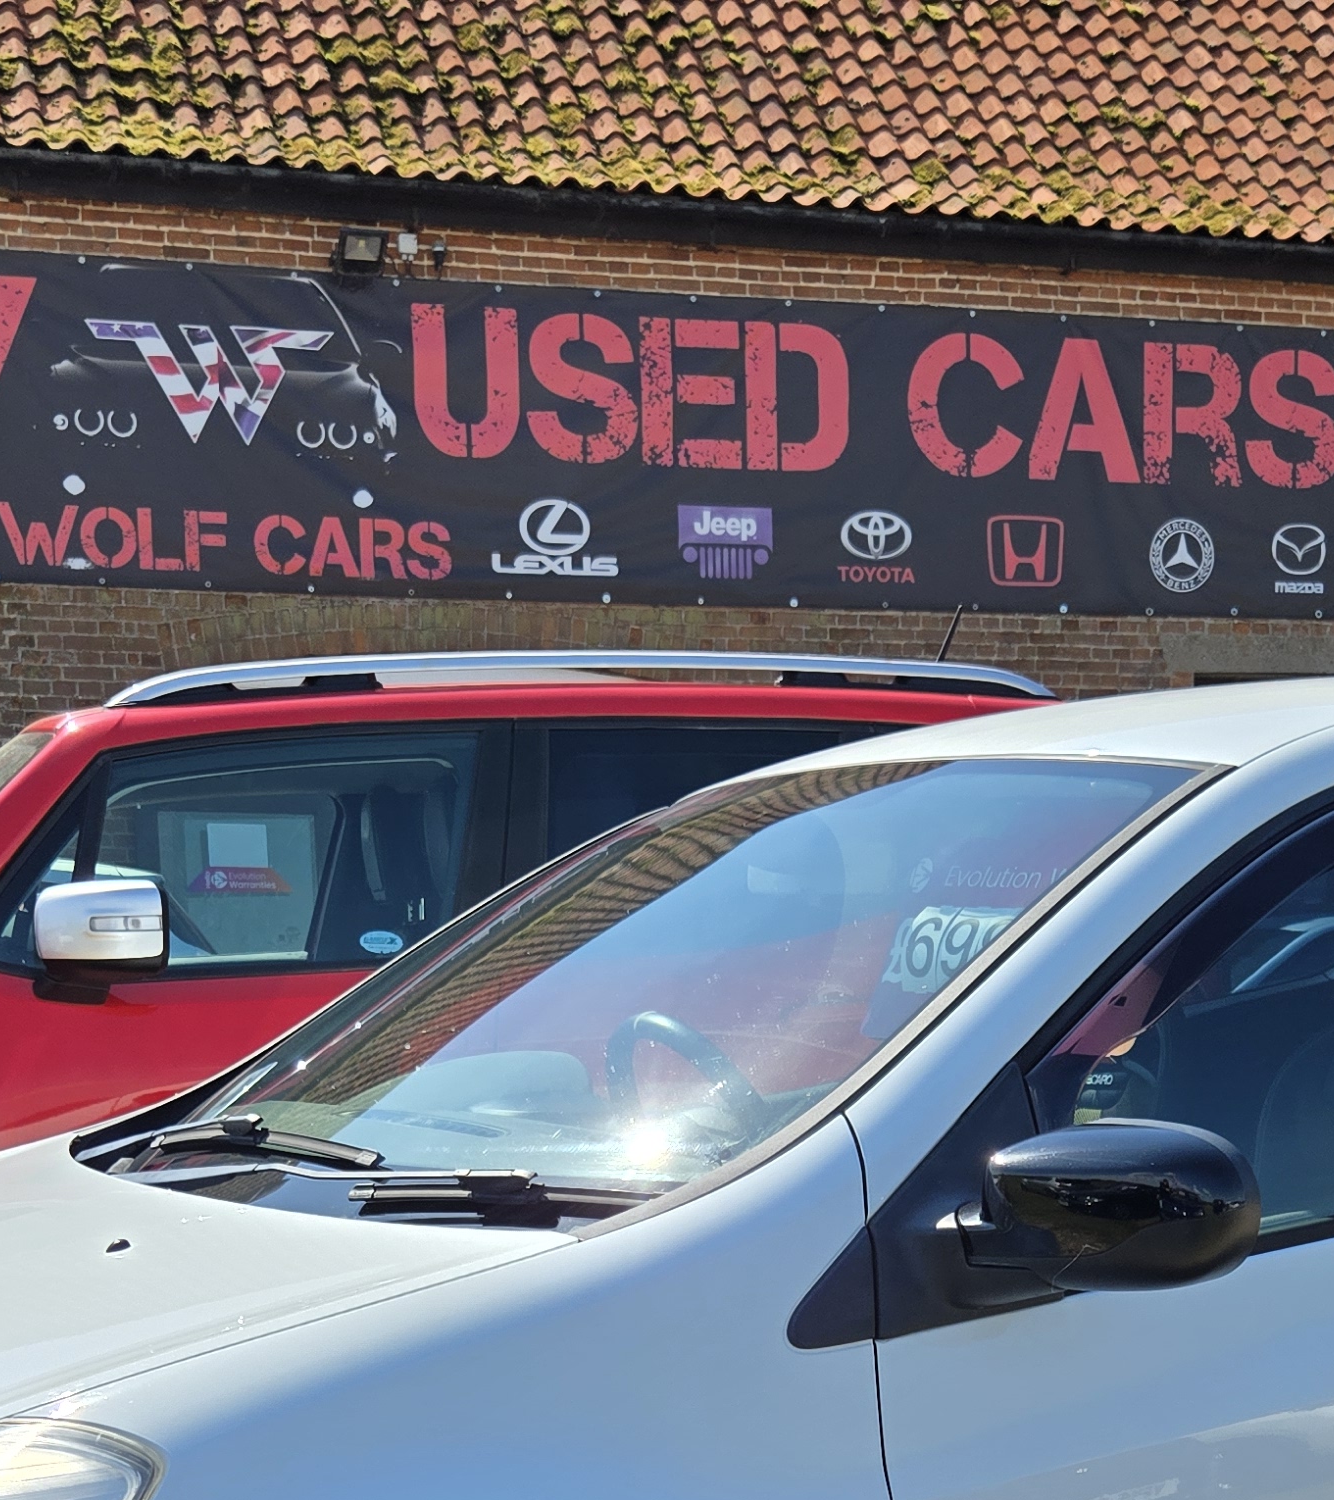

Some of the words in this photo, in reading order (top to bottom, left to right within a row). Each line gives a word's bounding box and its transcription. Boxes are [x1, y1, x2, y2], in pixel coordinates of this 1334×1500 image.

[410, 302, 850, 473] USED
[693, 508, 758, 542] Jeep
[1158, 521, 1207, 543] MERCEDES
[253, 514, 452, 580] CARS
[491, 552, 619, 577] LEXUS
[837, 564, 915, 584] TOYOTA
[1166, 578, 1197, 591] BENZ
[944, 865, 1042, 889] Evolution
